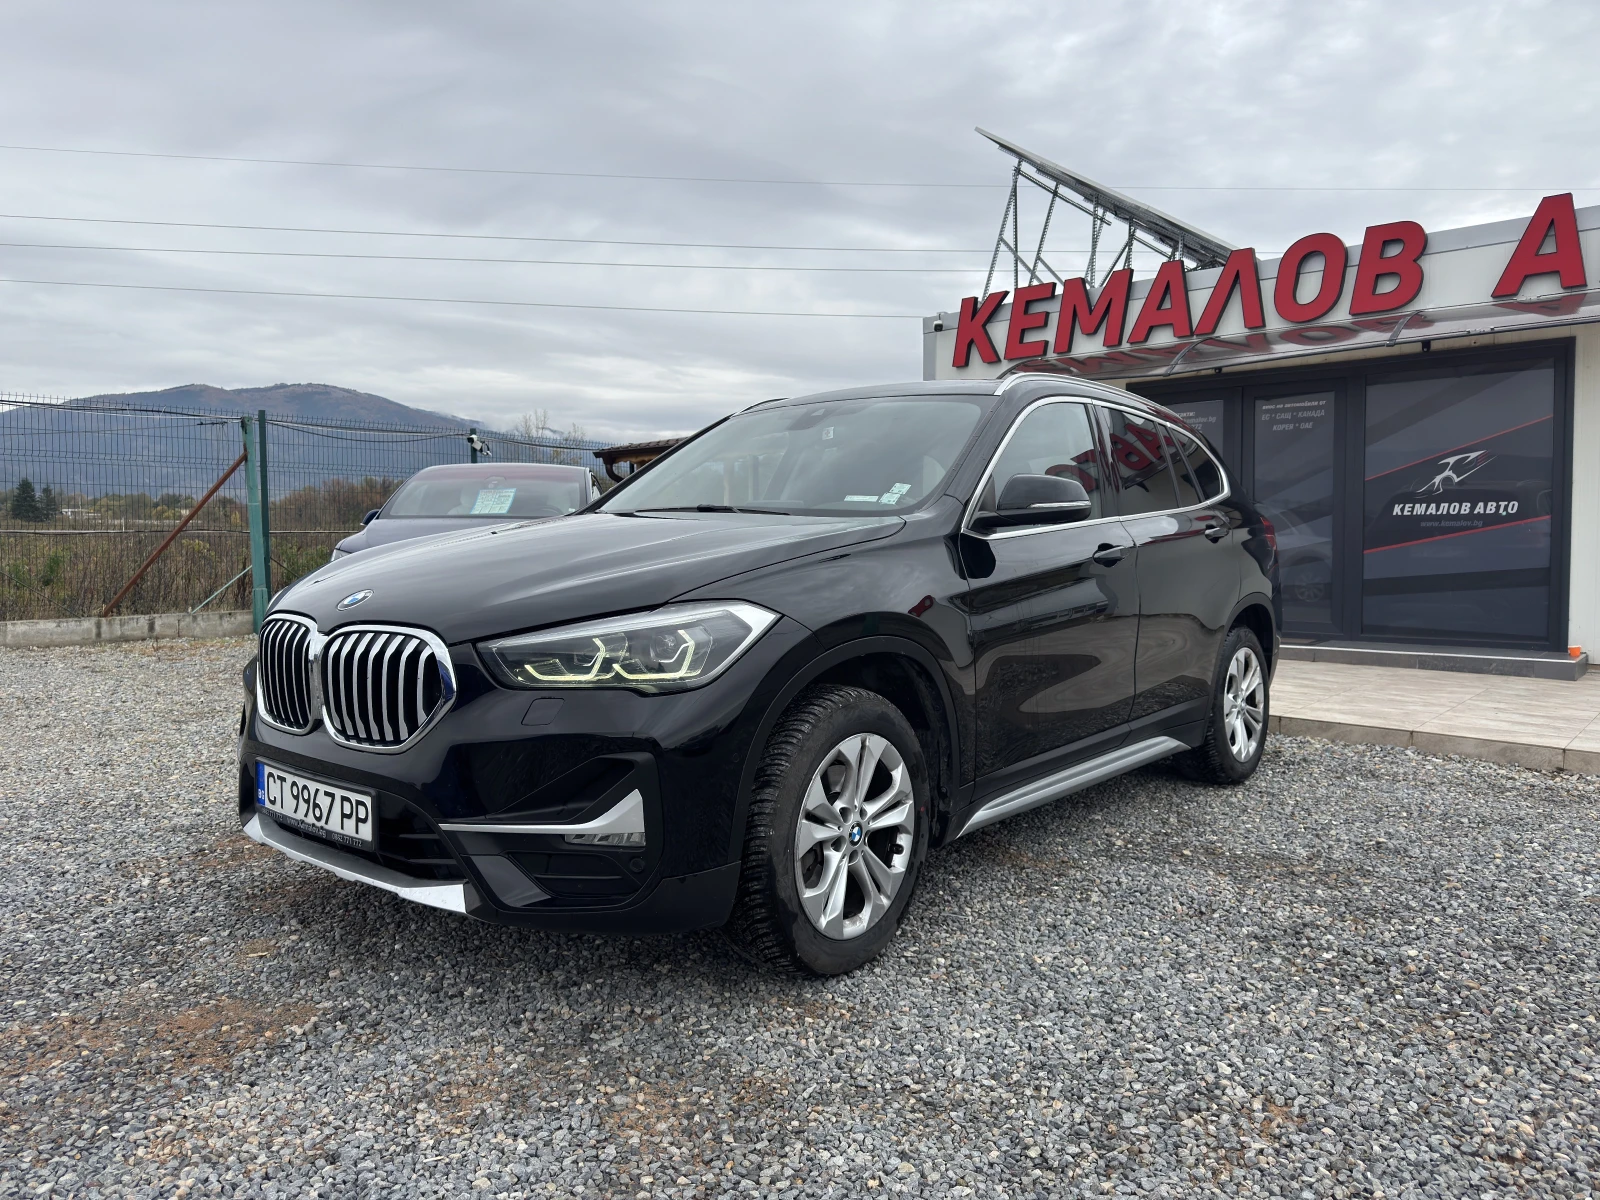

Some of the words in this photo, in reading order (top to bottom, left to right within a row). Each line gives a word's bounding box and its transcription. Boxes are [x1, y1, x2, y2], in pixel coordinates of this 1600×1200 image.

[952, 220, 1428, 368] КЕМАЛОВ
[1298, 409, 1325, 417] КАНАДА
[1392, 502, 1472, 516] КЕМАЛОВ
[1473, 501, 1519, 514] АВТО
[1420, 519, 1483, 527] www.kemalov.bg
[290, 780, 336, 826] 9967
